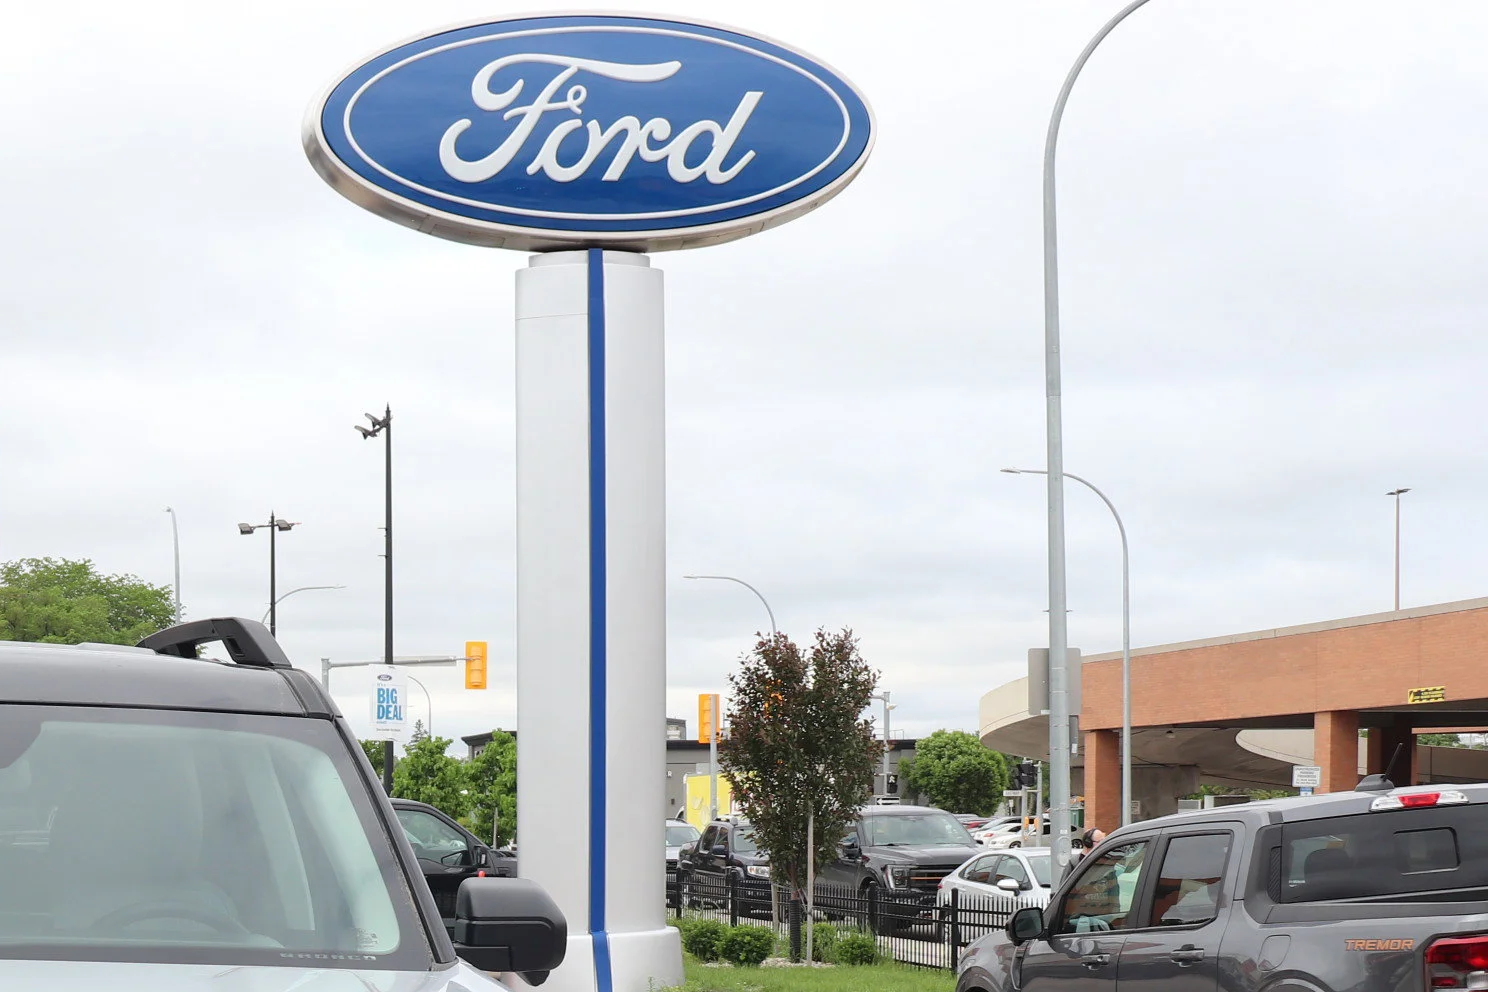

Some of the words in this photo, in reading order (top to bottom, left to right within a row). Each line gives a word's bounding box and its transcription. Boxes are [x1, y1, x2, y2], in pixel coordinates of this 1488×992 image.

[438, 52, 764, 185] Ford
[377, 687, 398, 704] BIG
[377, 704, 403, 721] DEAL
[1345, 938, 1416, 951] TREMOR
